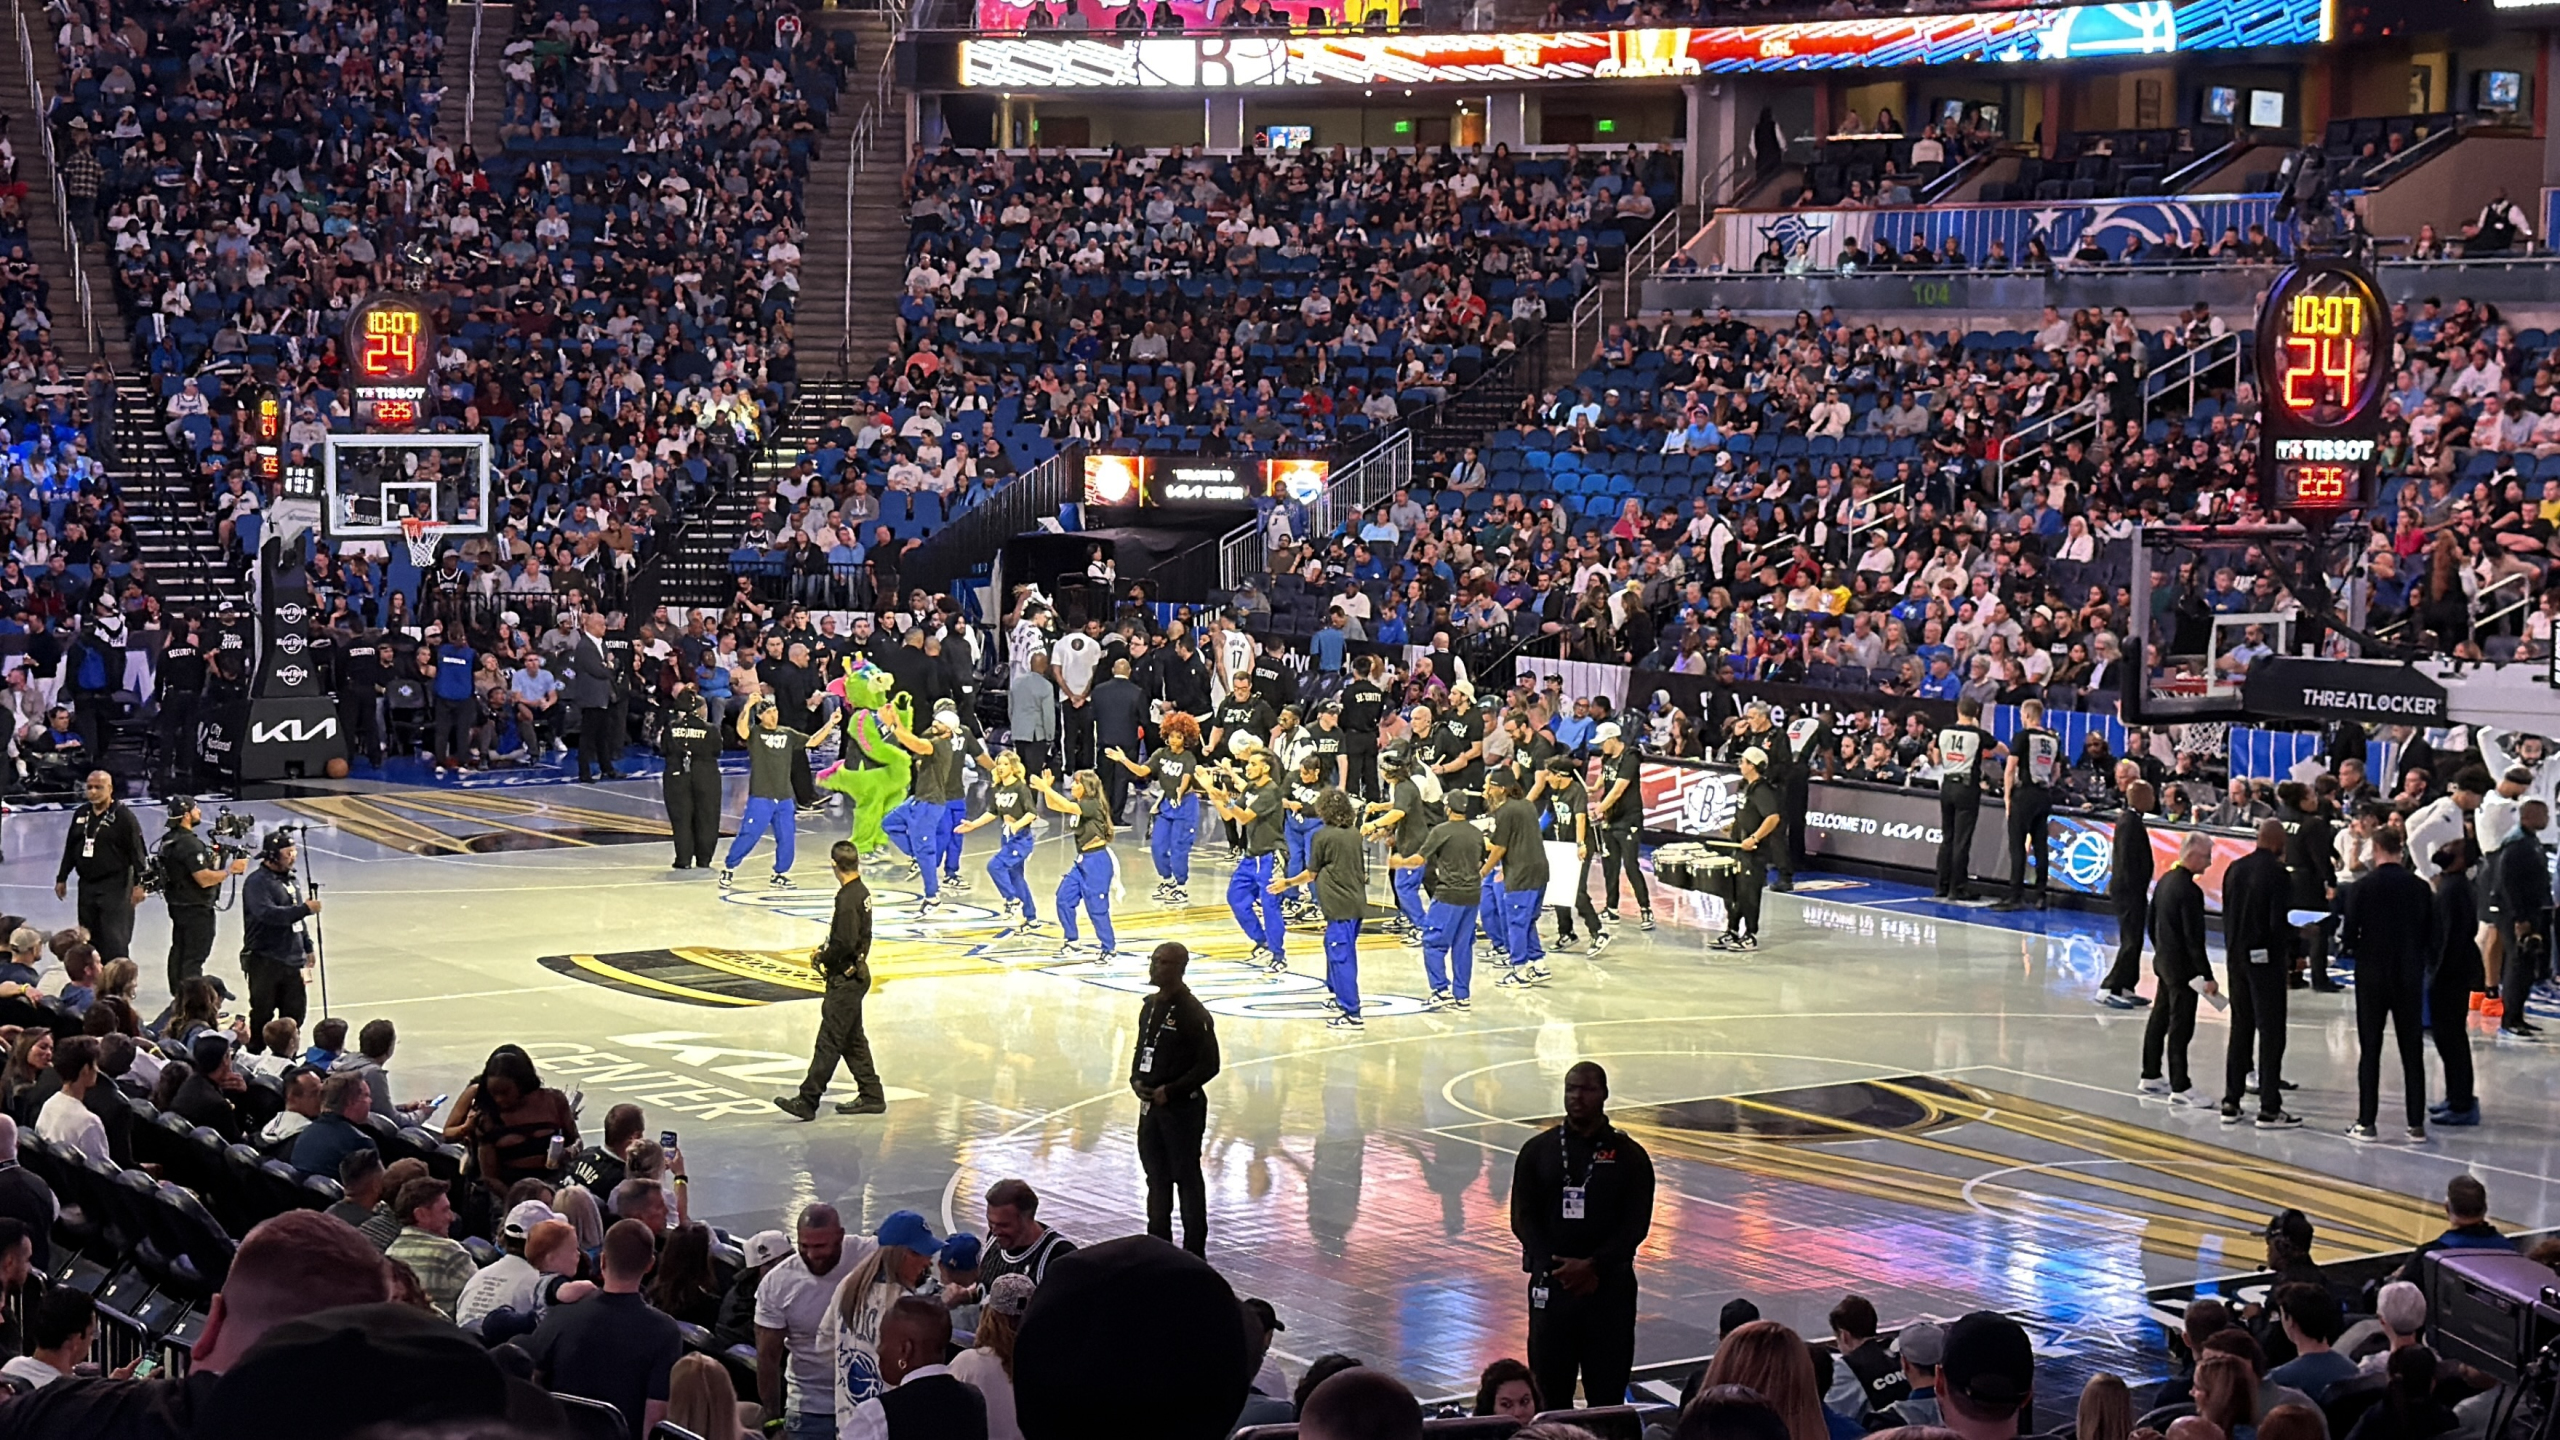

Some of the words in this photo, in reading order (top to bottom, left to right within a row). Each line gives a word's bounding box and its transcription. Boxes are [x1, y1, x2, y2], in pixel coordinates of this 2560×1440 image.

[369, 312, 417, 333] 10:07
[2293, 296, 2360, 334] 10:07
[366, 334, 413, 371] 24
[2286, 338, 2351, 407] 24
[2303, 440, 2374, 461] TISSOT
[2298, 468, 2342, 496] 2:25
[1232, 650, 1243, 669] 17
[2303, 688, 2437, 715] THREATLOCKER
[671, 727, 707, 739] SECURITY
[1951, 735, 1963, 751] 14
[1859, 818, 1877, 834] TO
